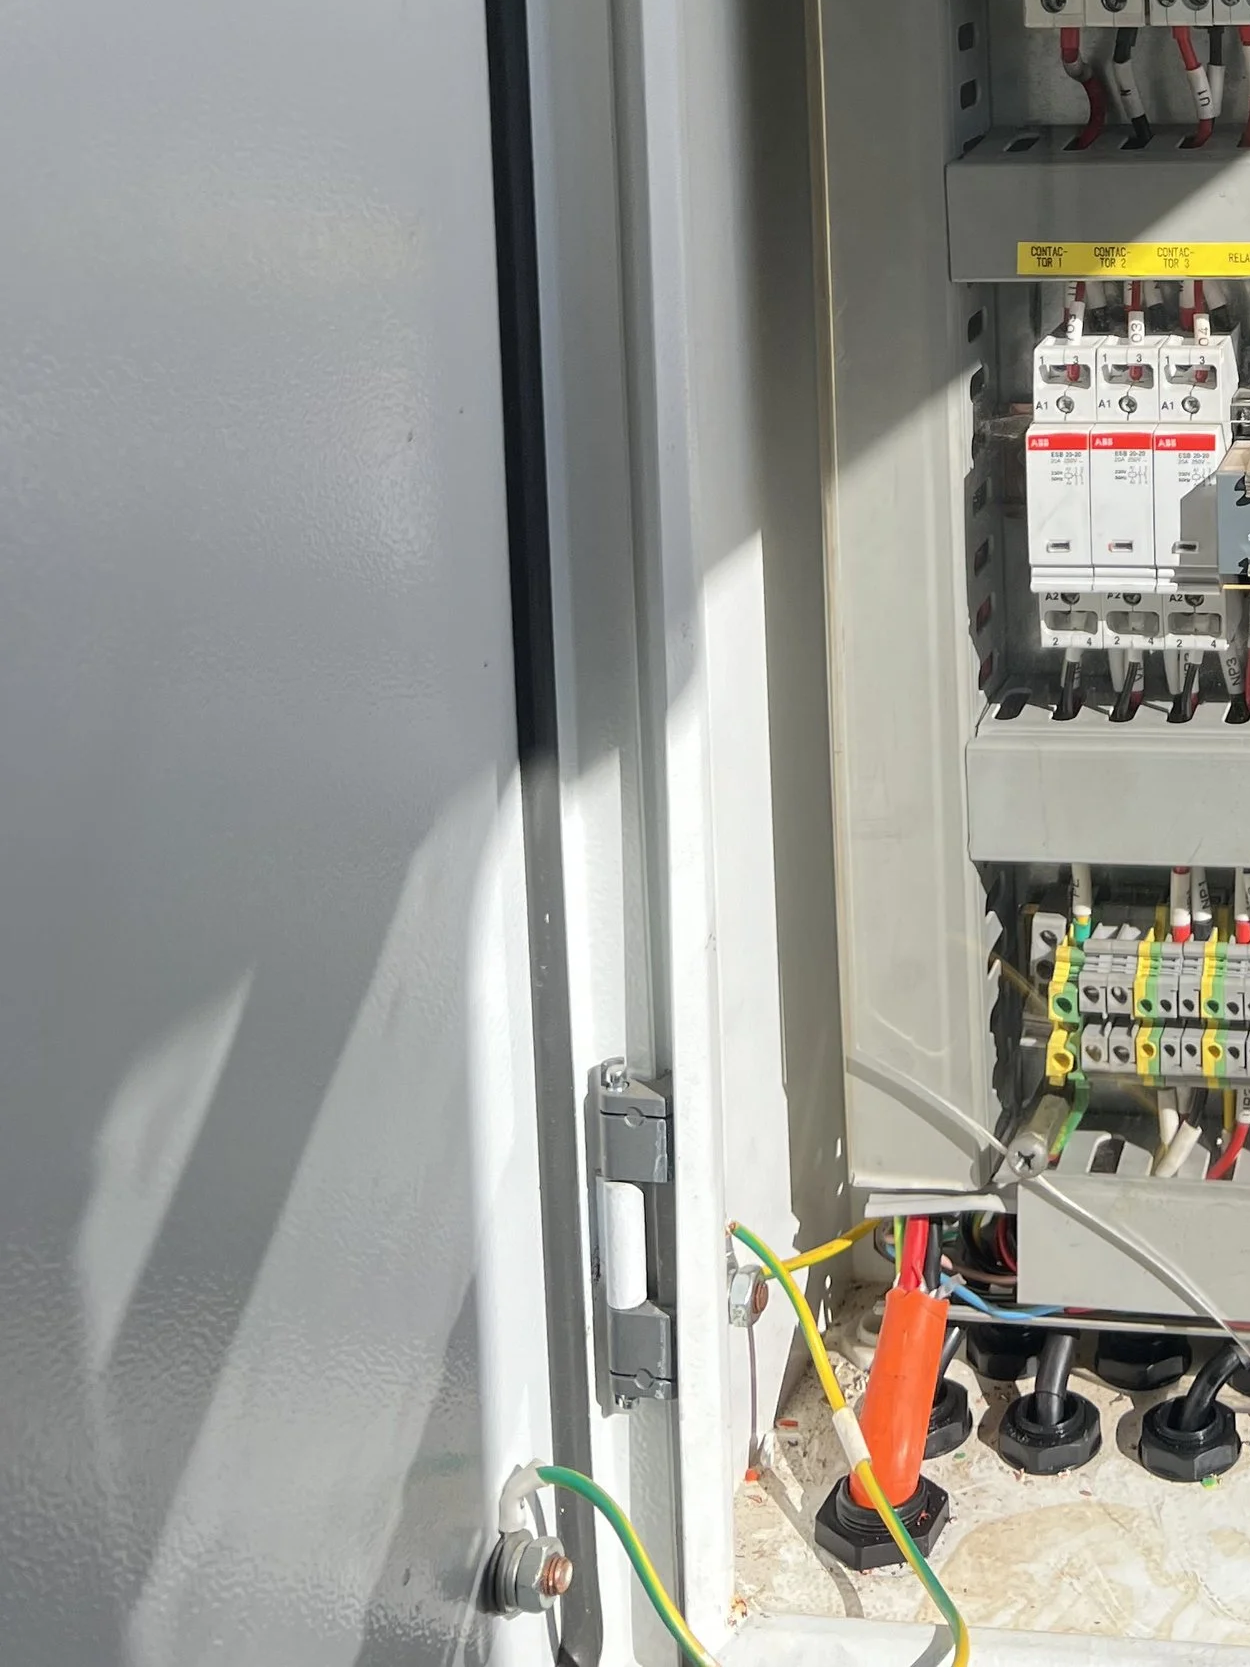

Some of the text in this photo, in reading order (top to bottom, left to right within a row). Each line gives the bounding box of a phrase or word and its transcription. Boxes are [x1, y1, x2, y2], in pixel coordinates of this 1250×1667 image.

[1199, 89, 1212, 108] U1
[1030, 246, 1068, 258] CONTAC-
[1093, 246, 1131, 258] CONTAC-
[1156, 246, 1195, 258] CONTAC-
[1036, 257, 1062, 268] TOR 1
[1099, 257, 1126, 268] TOR 2
[1162, 257, 1190, 268] TOR 3
[1035, 401, 1048, 410] A1
[1098, 399, 1111, 408] A1
[1161, 401, 1174, 411] A1
[1031, 438, 1049, 447] ABB
[1094, 437, 1113, 446] ABB
[1157, 438, 1176, 447] ABB
[1169, 593, 1183, 602] A2
[1052, 637, 1059, 646] 2
[1086, 637, 1092, 646] 4
[1114, 636, 1120, 645] 2
[1176, 639, 1183, 648] 2
[1210, 640, 1217, 648] 4
[1226, 656, 1241, 686] NP3
